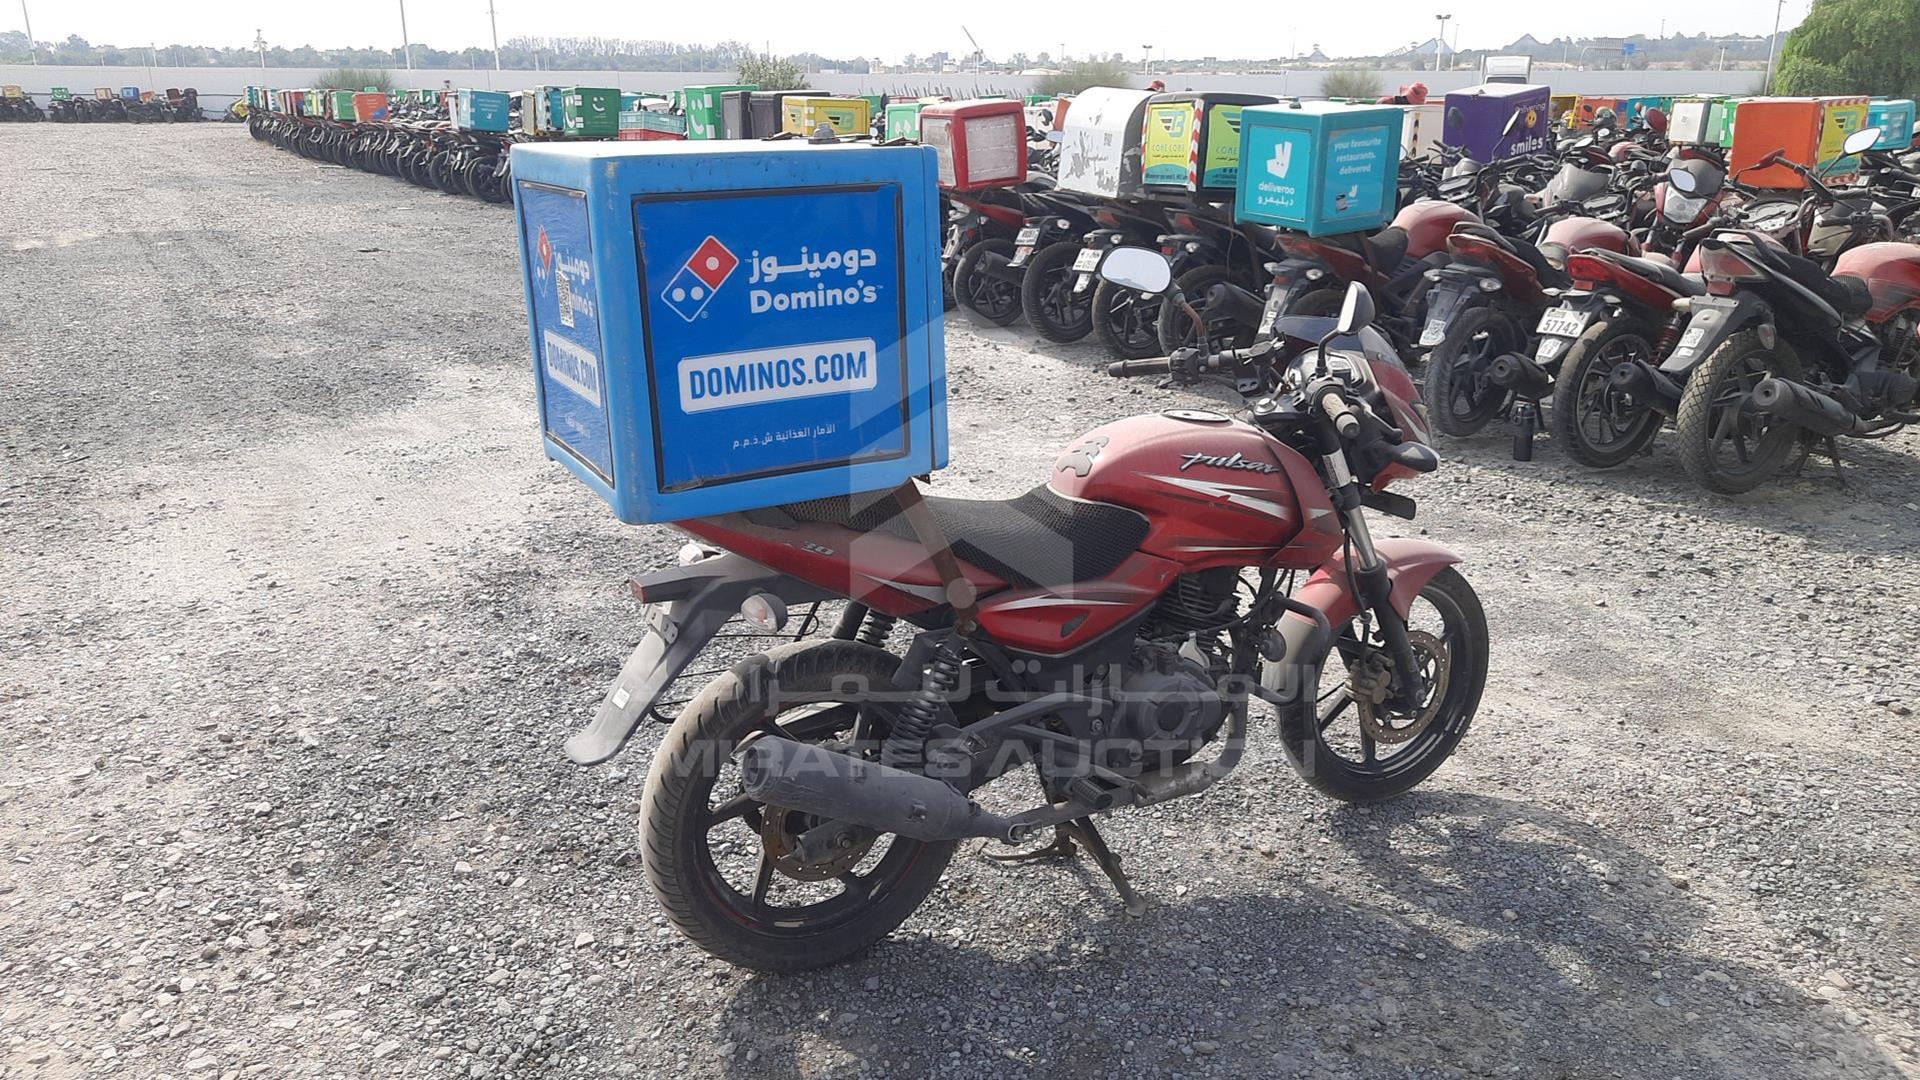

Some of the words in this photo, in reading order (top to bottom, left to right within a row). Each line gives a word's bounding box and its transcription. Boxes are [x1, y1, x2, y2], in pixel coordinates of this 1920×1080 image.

[1510, 136, 1543, 155] smiles
[1258, 181, 1296, 195] deliveroo
[749, 246, 877, 284] دومينوز
[750, 279, 878, 313] Domino's
[1542, 319, 1579, 336] 57742
[690, 351, 867, 400] DOMINOS.COM
